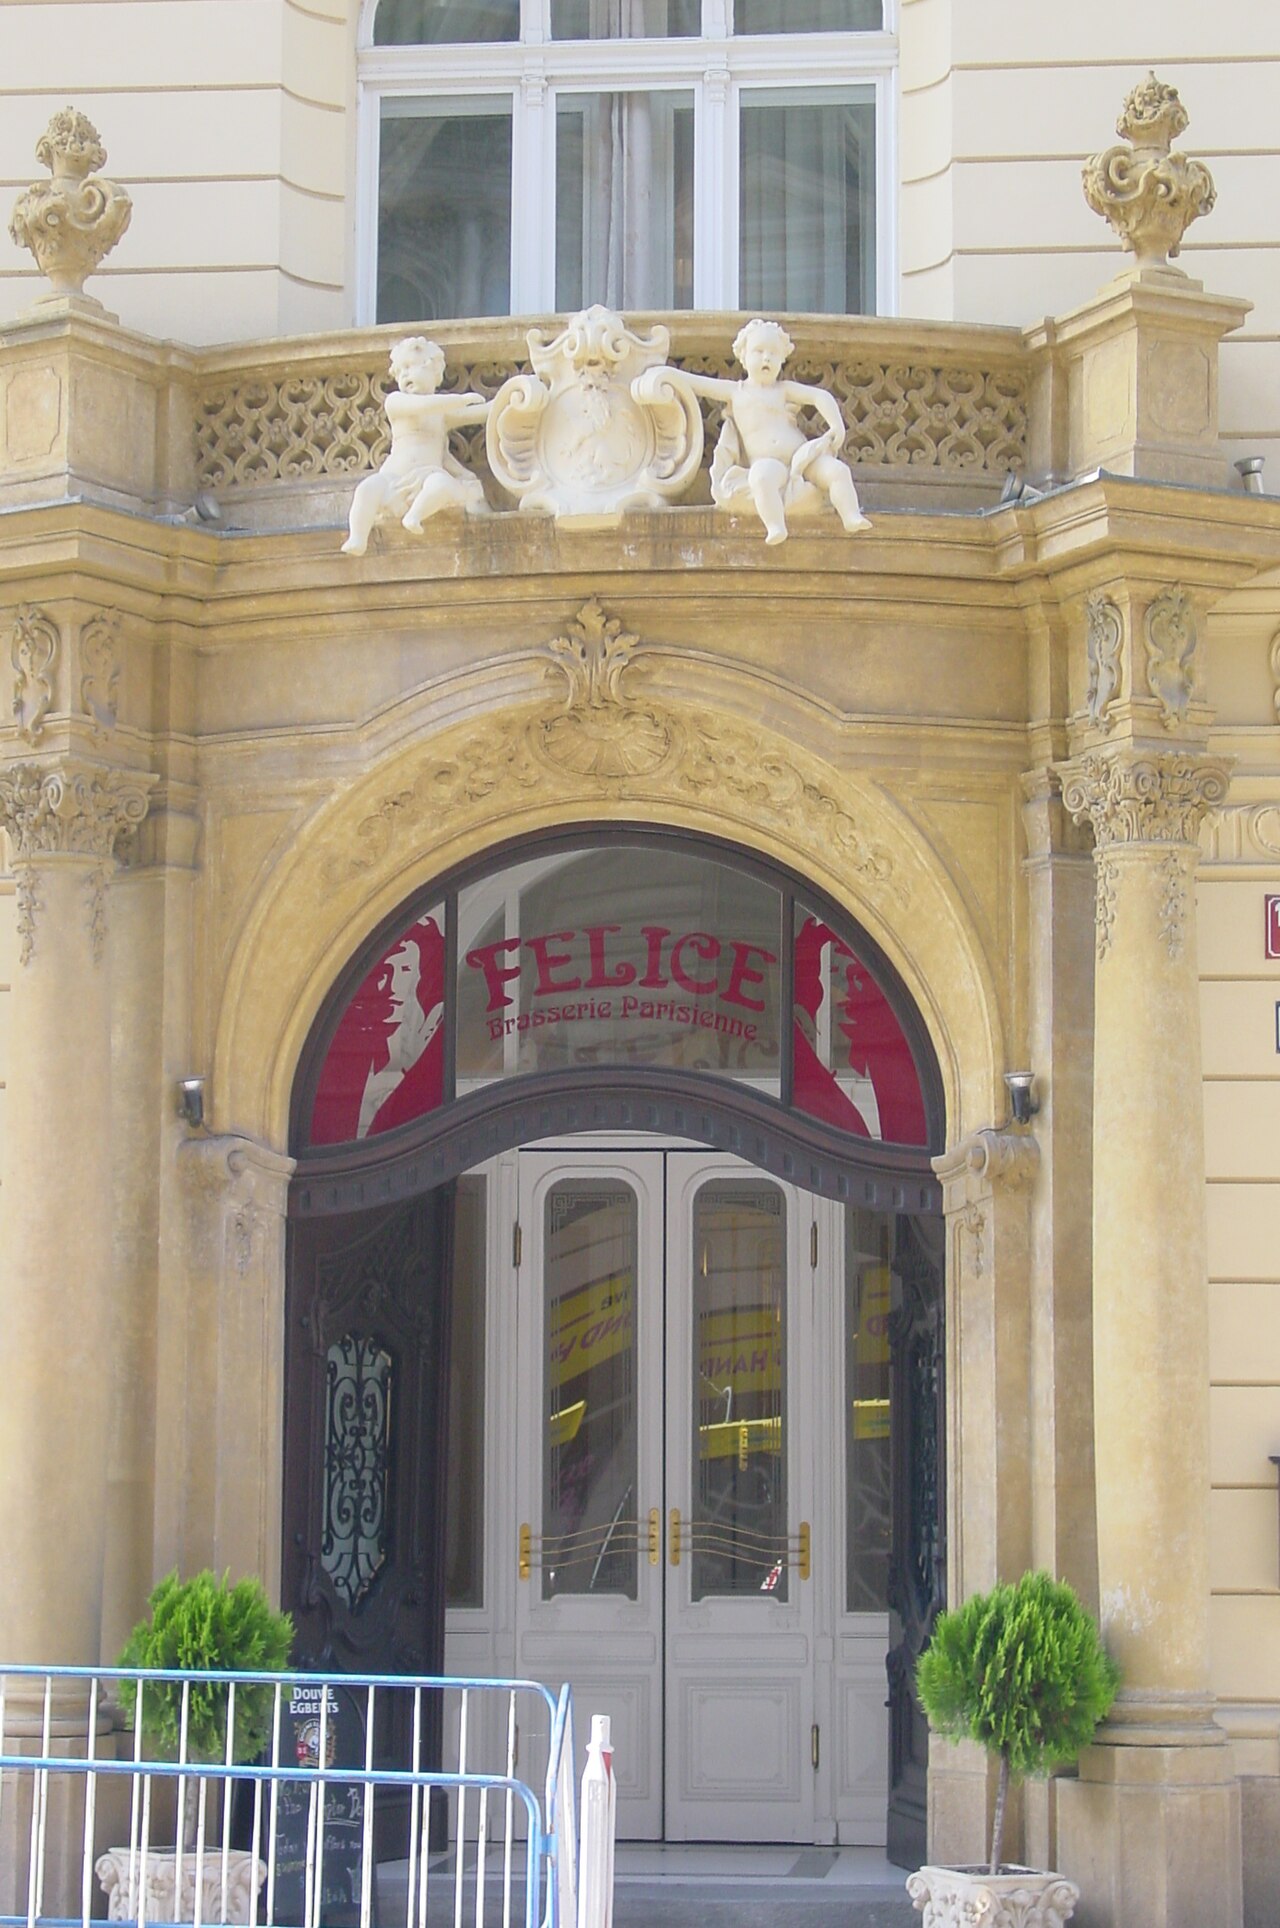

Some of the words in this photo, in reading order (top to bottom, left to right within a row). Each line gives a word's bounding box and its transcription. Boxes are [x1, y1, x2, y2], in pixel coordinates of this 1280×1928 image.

[466, 926, 777, 1012] FELICE
[486, 998, 611, 1040] Brasserie
[620, 995, 757, 1040] Parisienne
[290, 1701, 339, 1714] EGBETS
